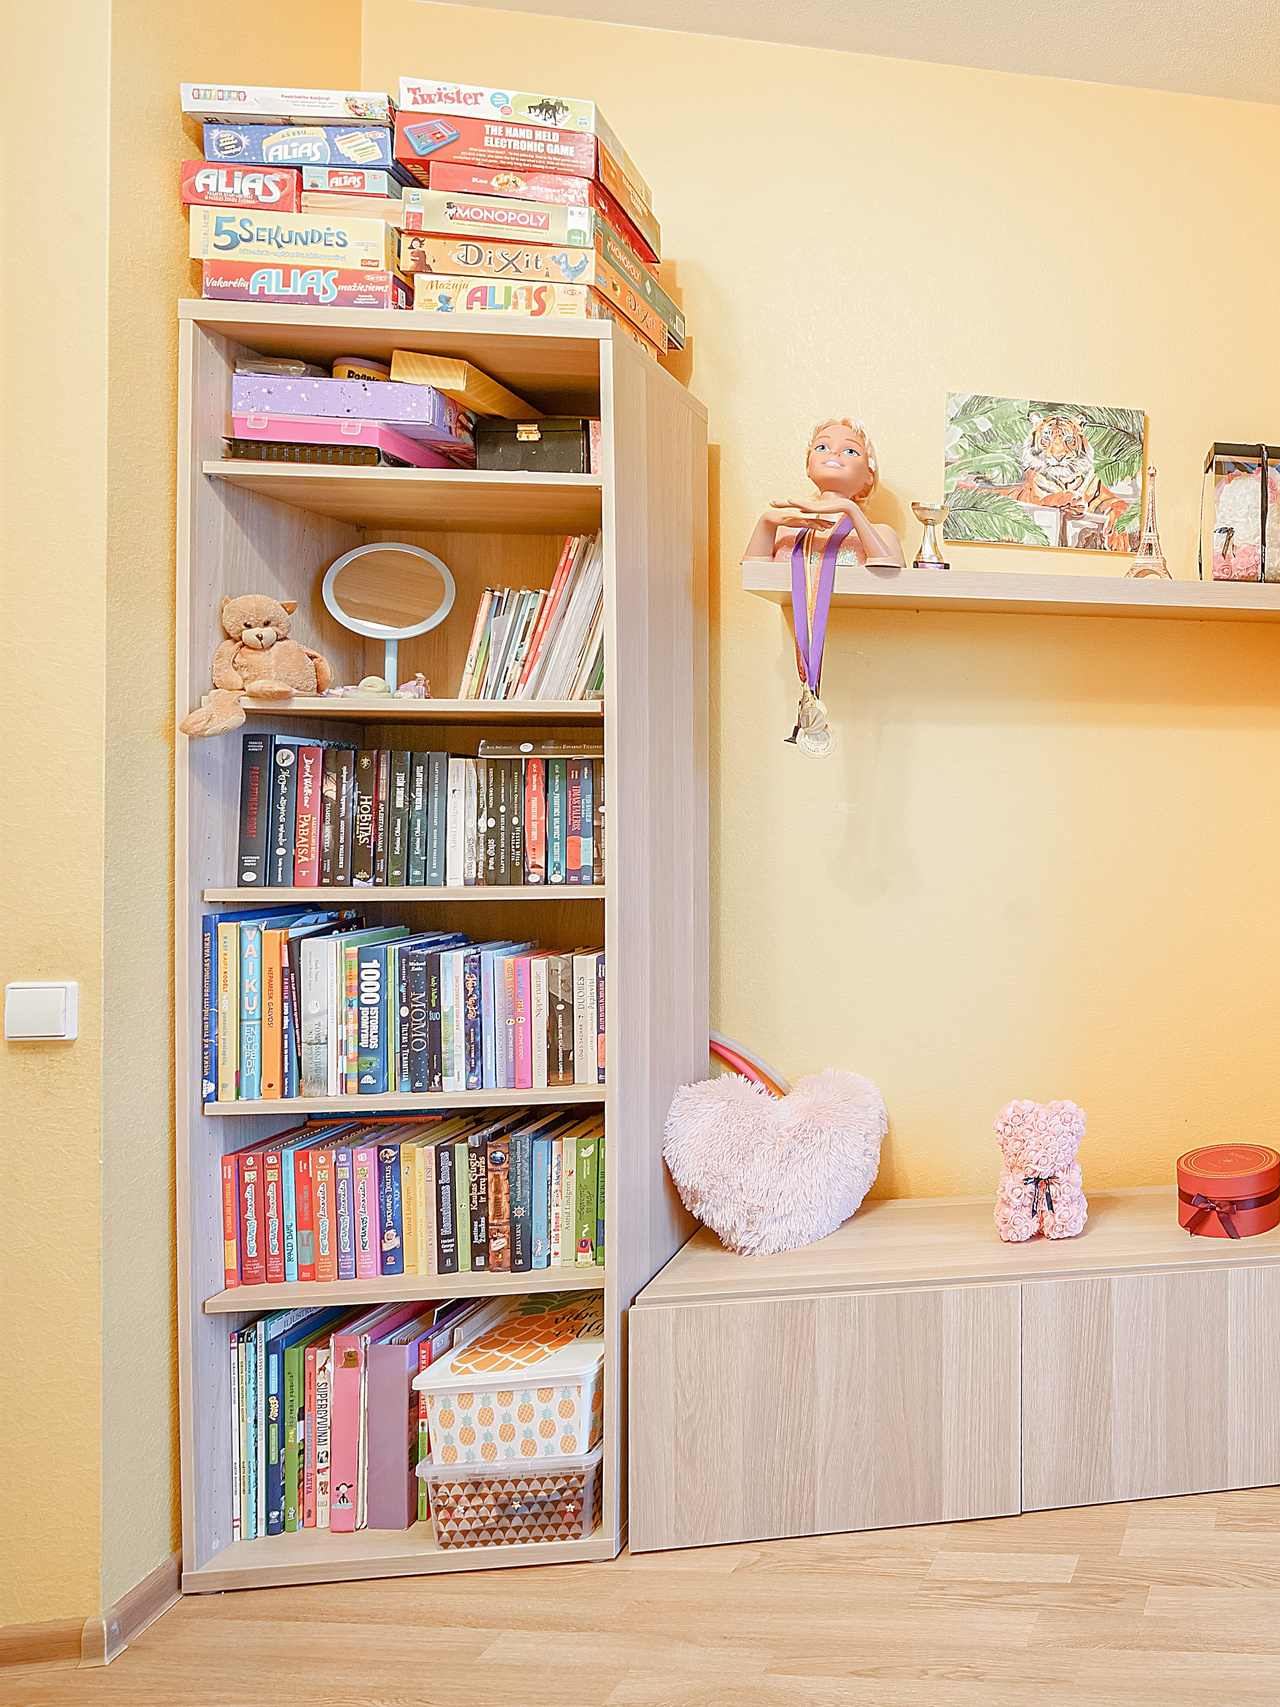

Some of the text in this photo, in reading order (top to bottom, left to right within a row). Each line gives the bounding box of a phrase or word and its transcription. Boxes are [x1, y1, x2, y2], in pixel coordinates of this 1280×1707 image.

[407, 87, 484, 106] Twister
[484, 125, 560, 143] THE HAND HELD
[484, 136, 575, 157] ELECTRONIC GAME
[455, 206, 547, 227] MONOPOLY
[213, 216, 348, 250] 5 SEKUNDĖS
[205, 277, 249, 293] Vakarėlių
[249, 268, 339, 303] ALIAS
[204, 933, 212, 959] VAIKAS
[360, 959, 381, 1004] 1000
[369, 1006, 379, 1049] ISTORIJOS
[411, 992, 427, 1052] MOMO
[564, 1181, 572, 1210] Lindgren
